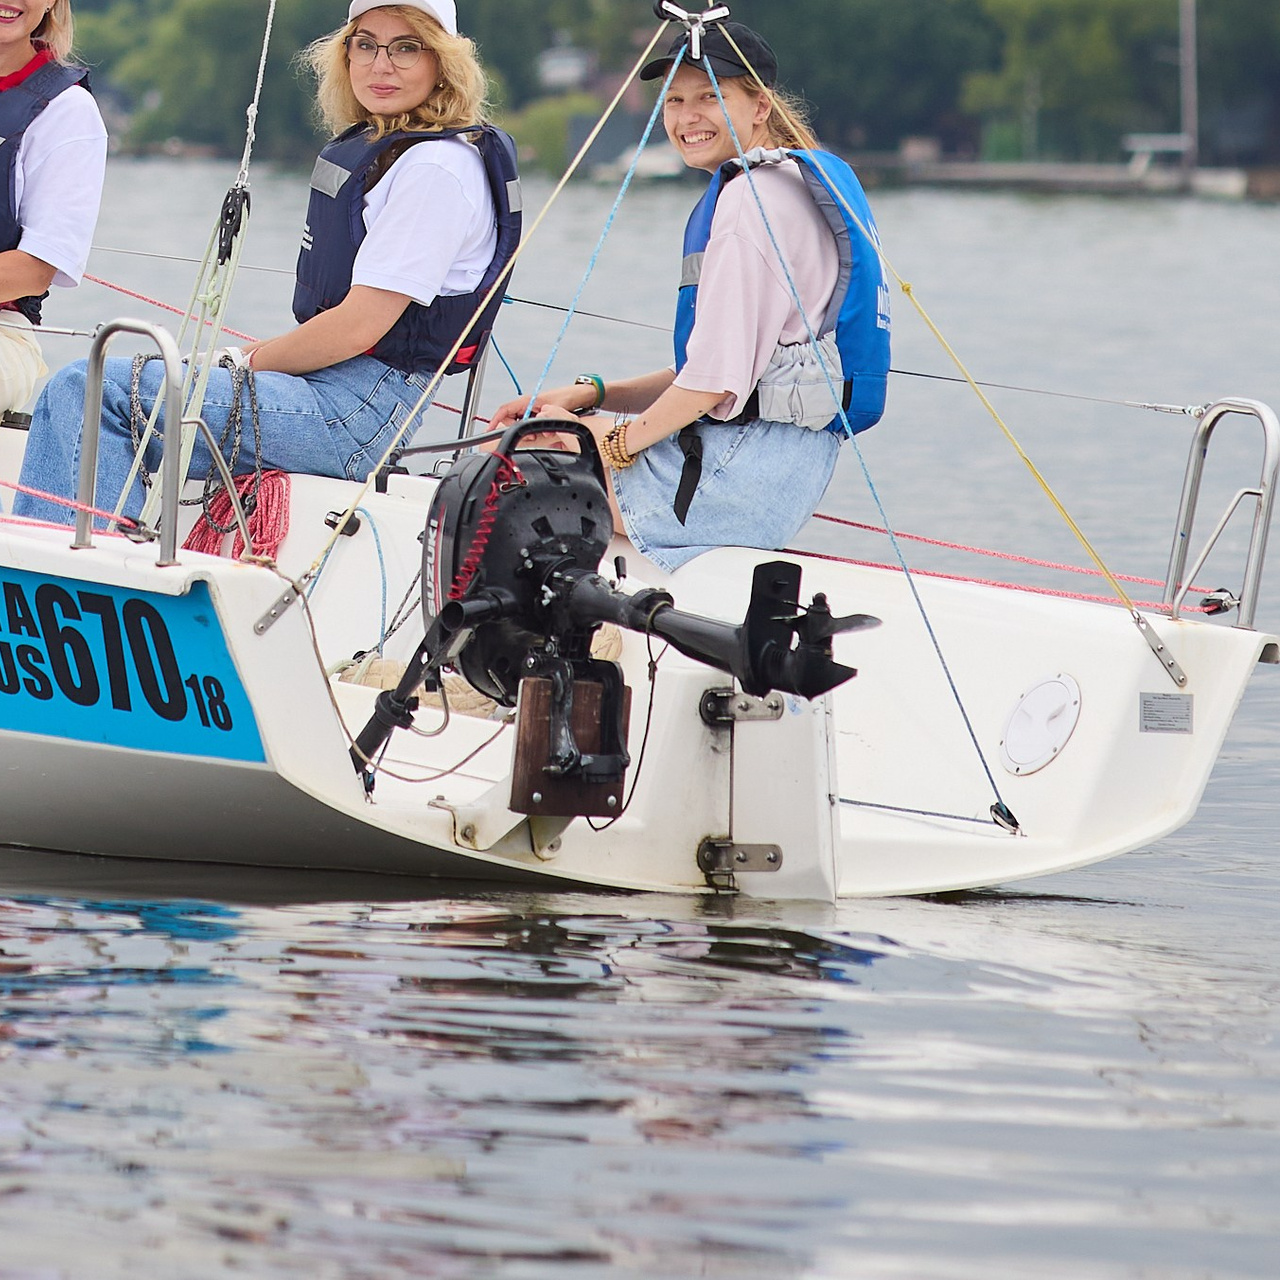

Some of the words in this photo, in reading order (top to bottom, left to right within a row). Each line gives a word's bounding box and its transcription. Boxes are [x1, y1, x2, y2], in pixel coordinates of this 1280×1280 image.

[426, 518, 439, 618] SUZUKI
[35, 583, 187, 722] 670
[185, 673, 233, 732] 18
